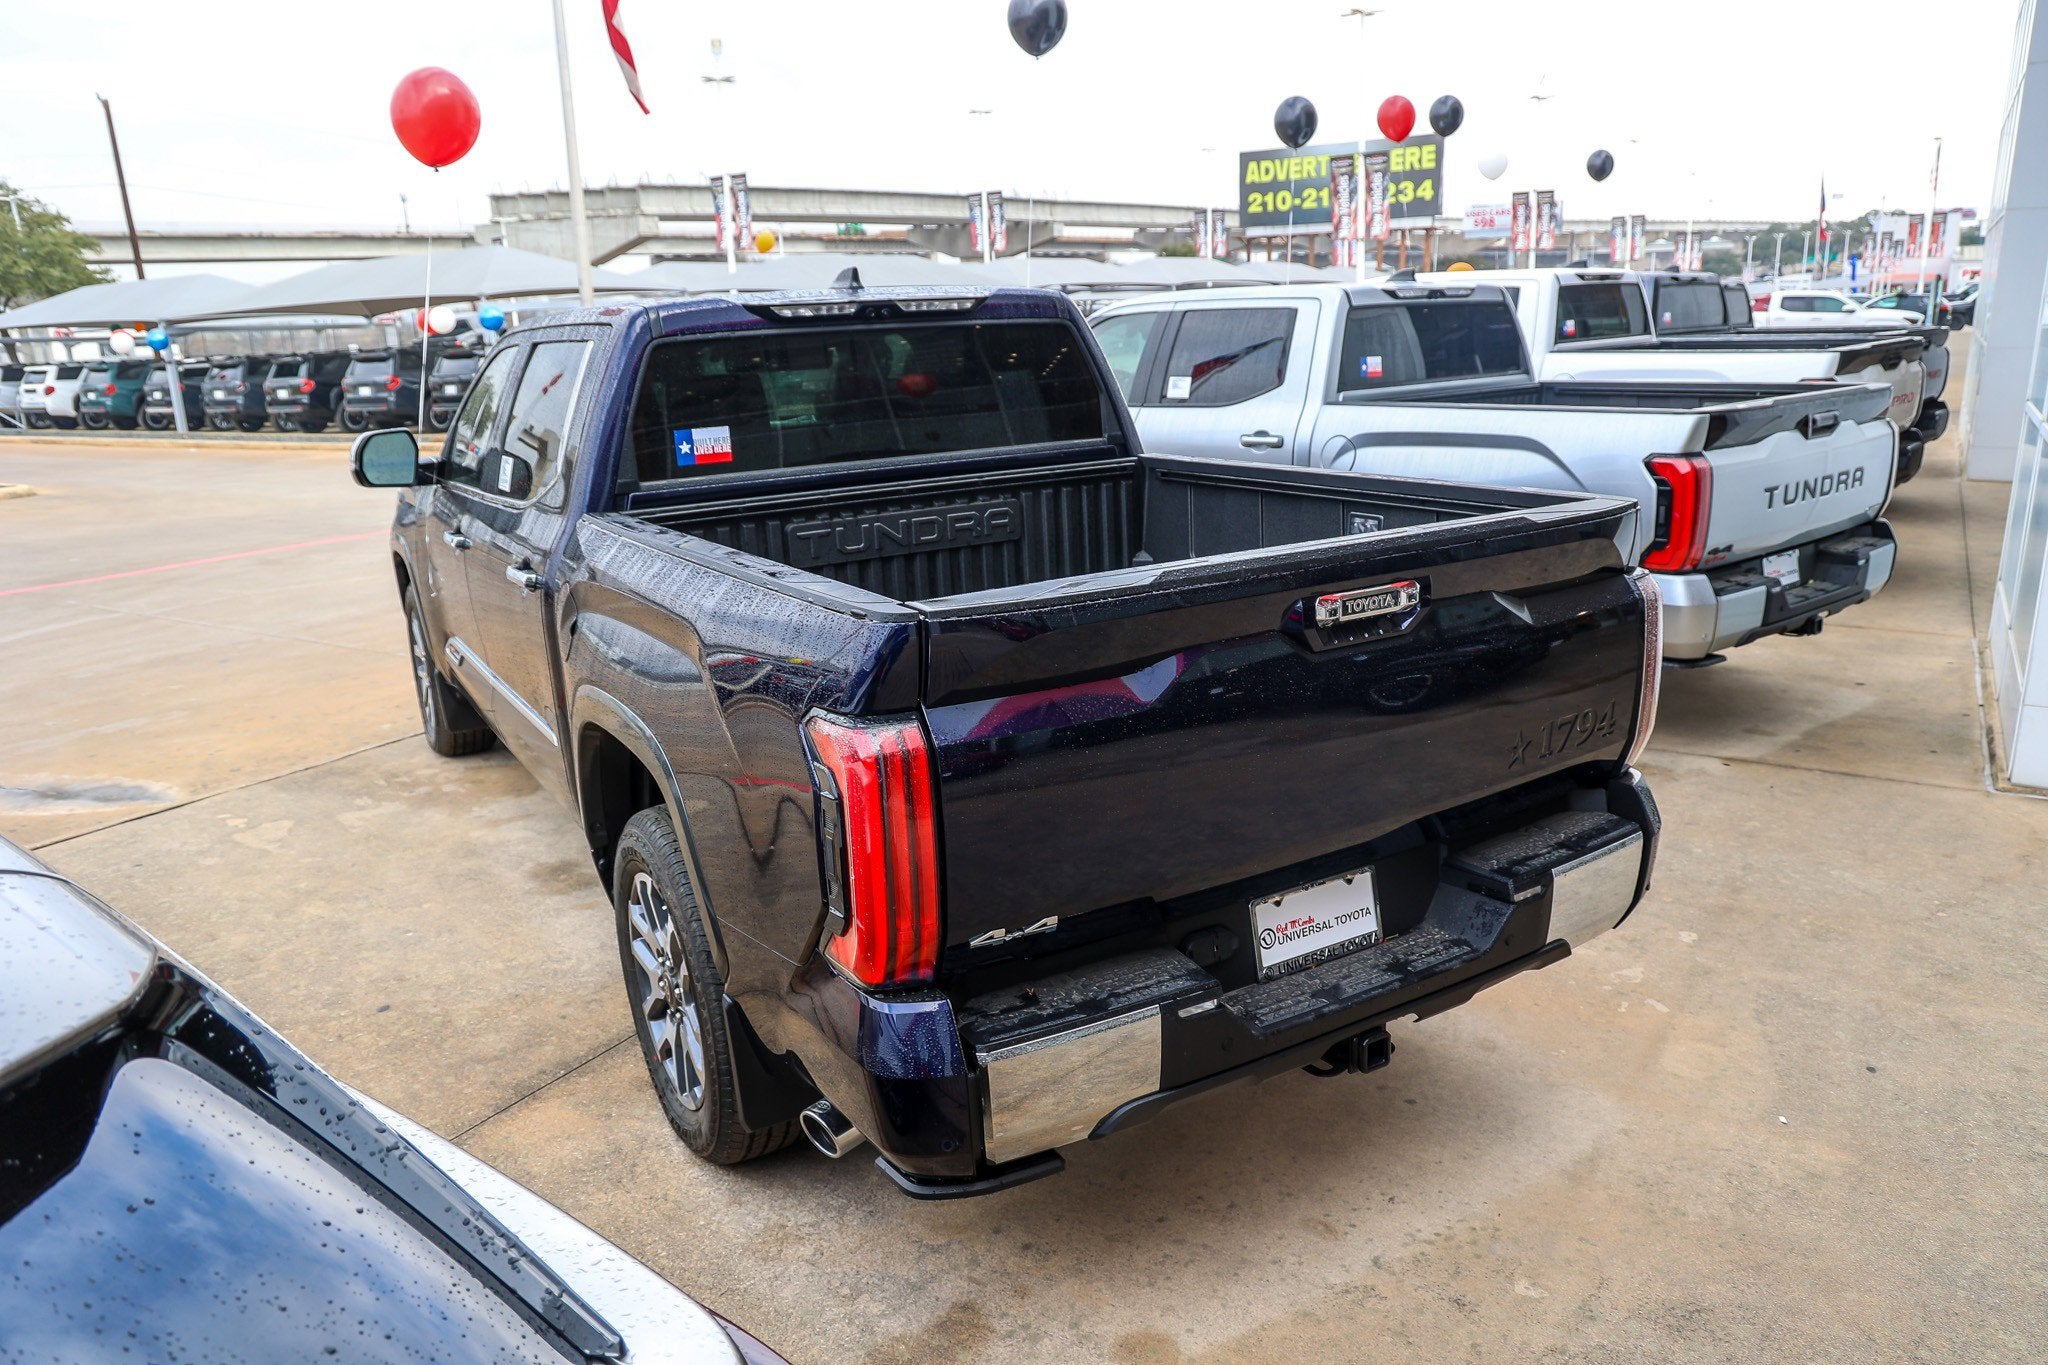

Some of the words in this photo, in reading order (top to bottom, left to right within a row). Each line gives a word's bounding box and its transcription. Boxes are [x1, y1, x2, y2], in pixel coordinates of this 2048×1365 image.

[1388, 143, 1437, 173] ERE
[1337, 174, 1351, 216] Vehicles
[1369, 171, 1384, 214] Vehicles
[1338, 215, 1352, 239] New
[1369, 213, 1384, 238] New
[714, 443, 732, 454] HERE
[1764, 465, 1865, 511] TUNDRA
[796, 507, 1014, 559] TUNDRA
[1345, 593, 1396, 614] TOYOTA
[1538, 697, 1617, 760] 1794
[1277, 919, 1334, 946] UNIVERSAL
[1334, 906, 1372, 926] TOYOTA
[1277, 947, 1339, 976] UNIVERSAL
[1340, 931, 1380, 953] TOYOTA
